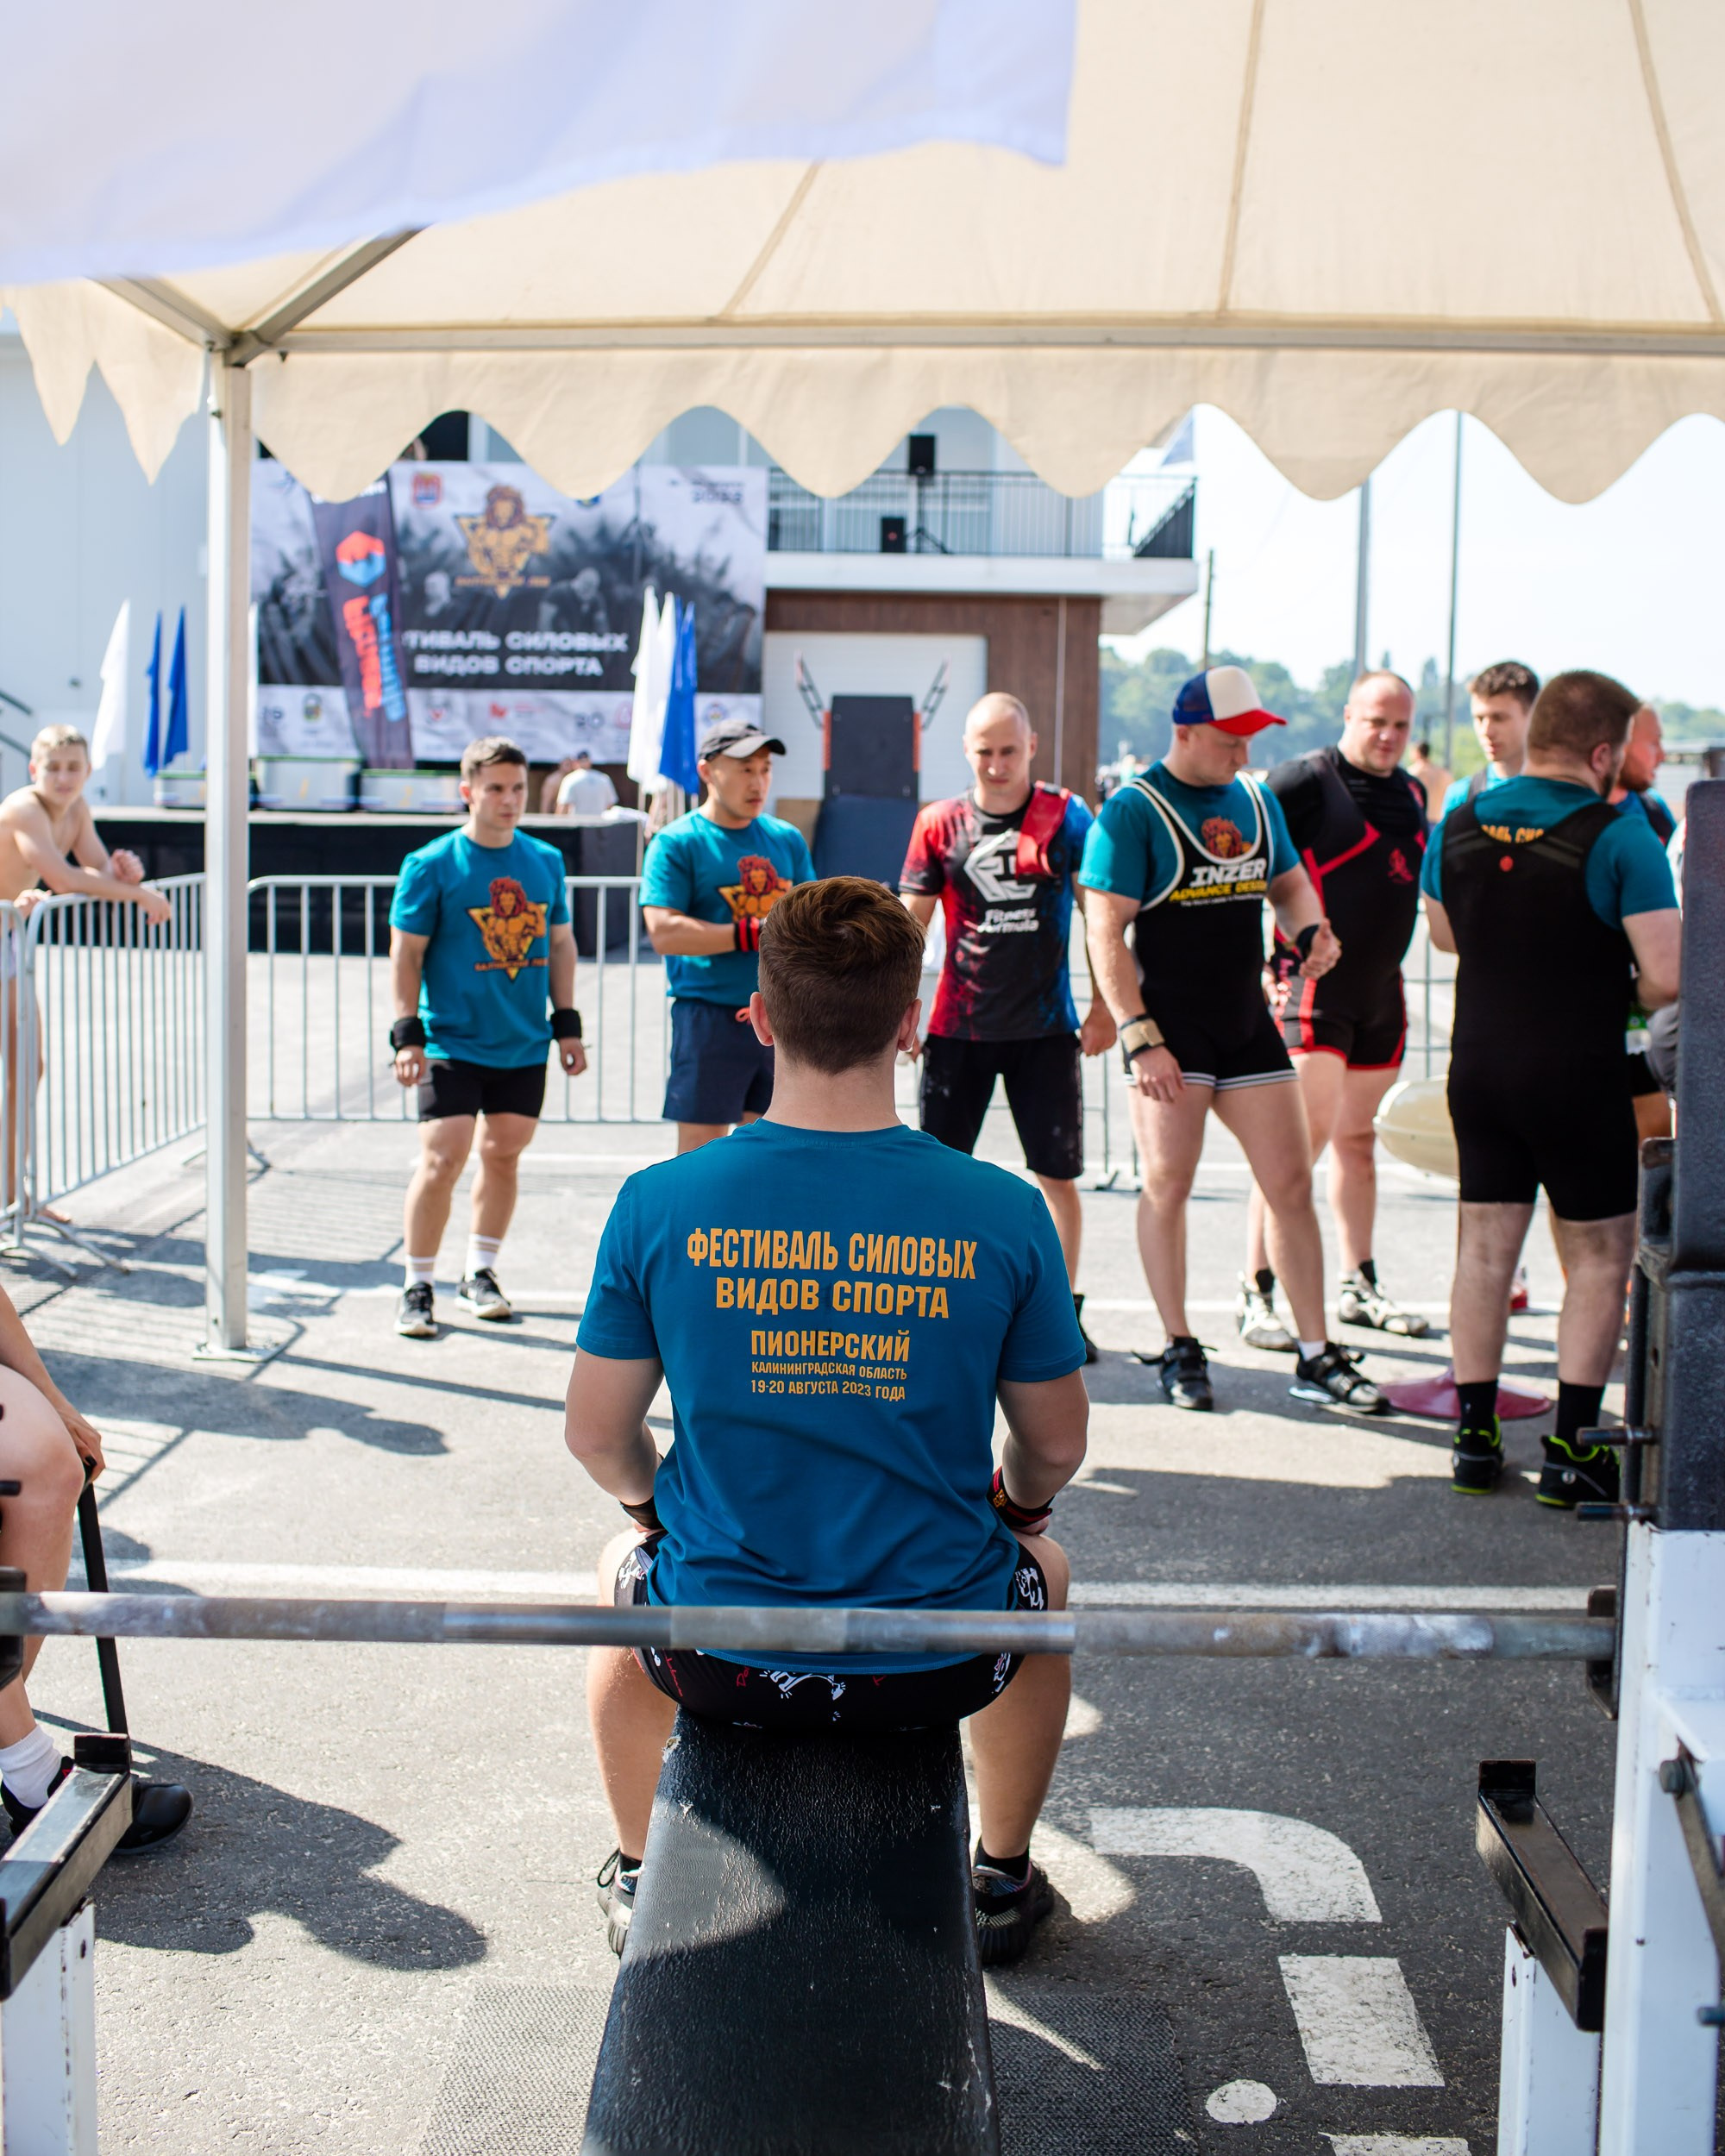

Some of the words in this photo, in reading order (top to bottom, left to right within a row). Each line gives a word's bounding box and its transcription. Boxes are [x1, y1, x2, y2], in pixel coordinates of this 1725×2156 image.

[403, 630, 500, 650] ТИВАЛЬ
[505, 631, 628, 652] СИЛОВЫХ
[414, 655, 499, 676] ВИДОВ
[505, 655, 603, 675] СПОРТА
[1189, 858, 1267, 887] INZER
[1170, 883, 1232, 901] ADVANCE
[687, 1228, 838, 1270] ФЕСТИВАЛЬ
[849, 1233, 977, 1279] СИЛОВЫХ
[716, 1277, 819, 1315] ВИДОВ
[832, 1280, 949, 1319] СПОРТА
[751, 1330, 910, 1362] ПИОНЕРСКИЙ
[751, 1362, 856, 1376] КАЛИНИНГРАДСКАЯ
[859, 1366, 907, 1380] ОБЛАСТЬ
[751, 1380, 784, 1394] 19-20
[788, 1381, 838, 1395] АВГУСТА
[843, 1382, 871, 1397] 2023
[875, 1386, 906, 1401] ГОДА
